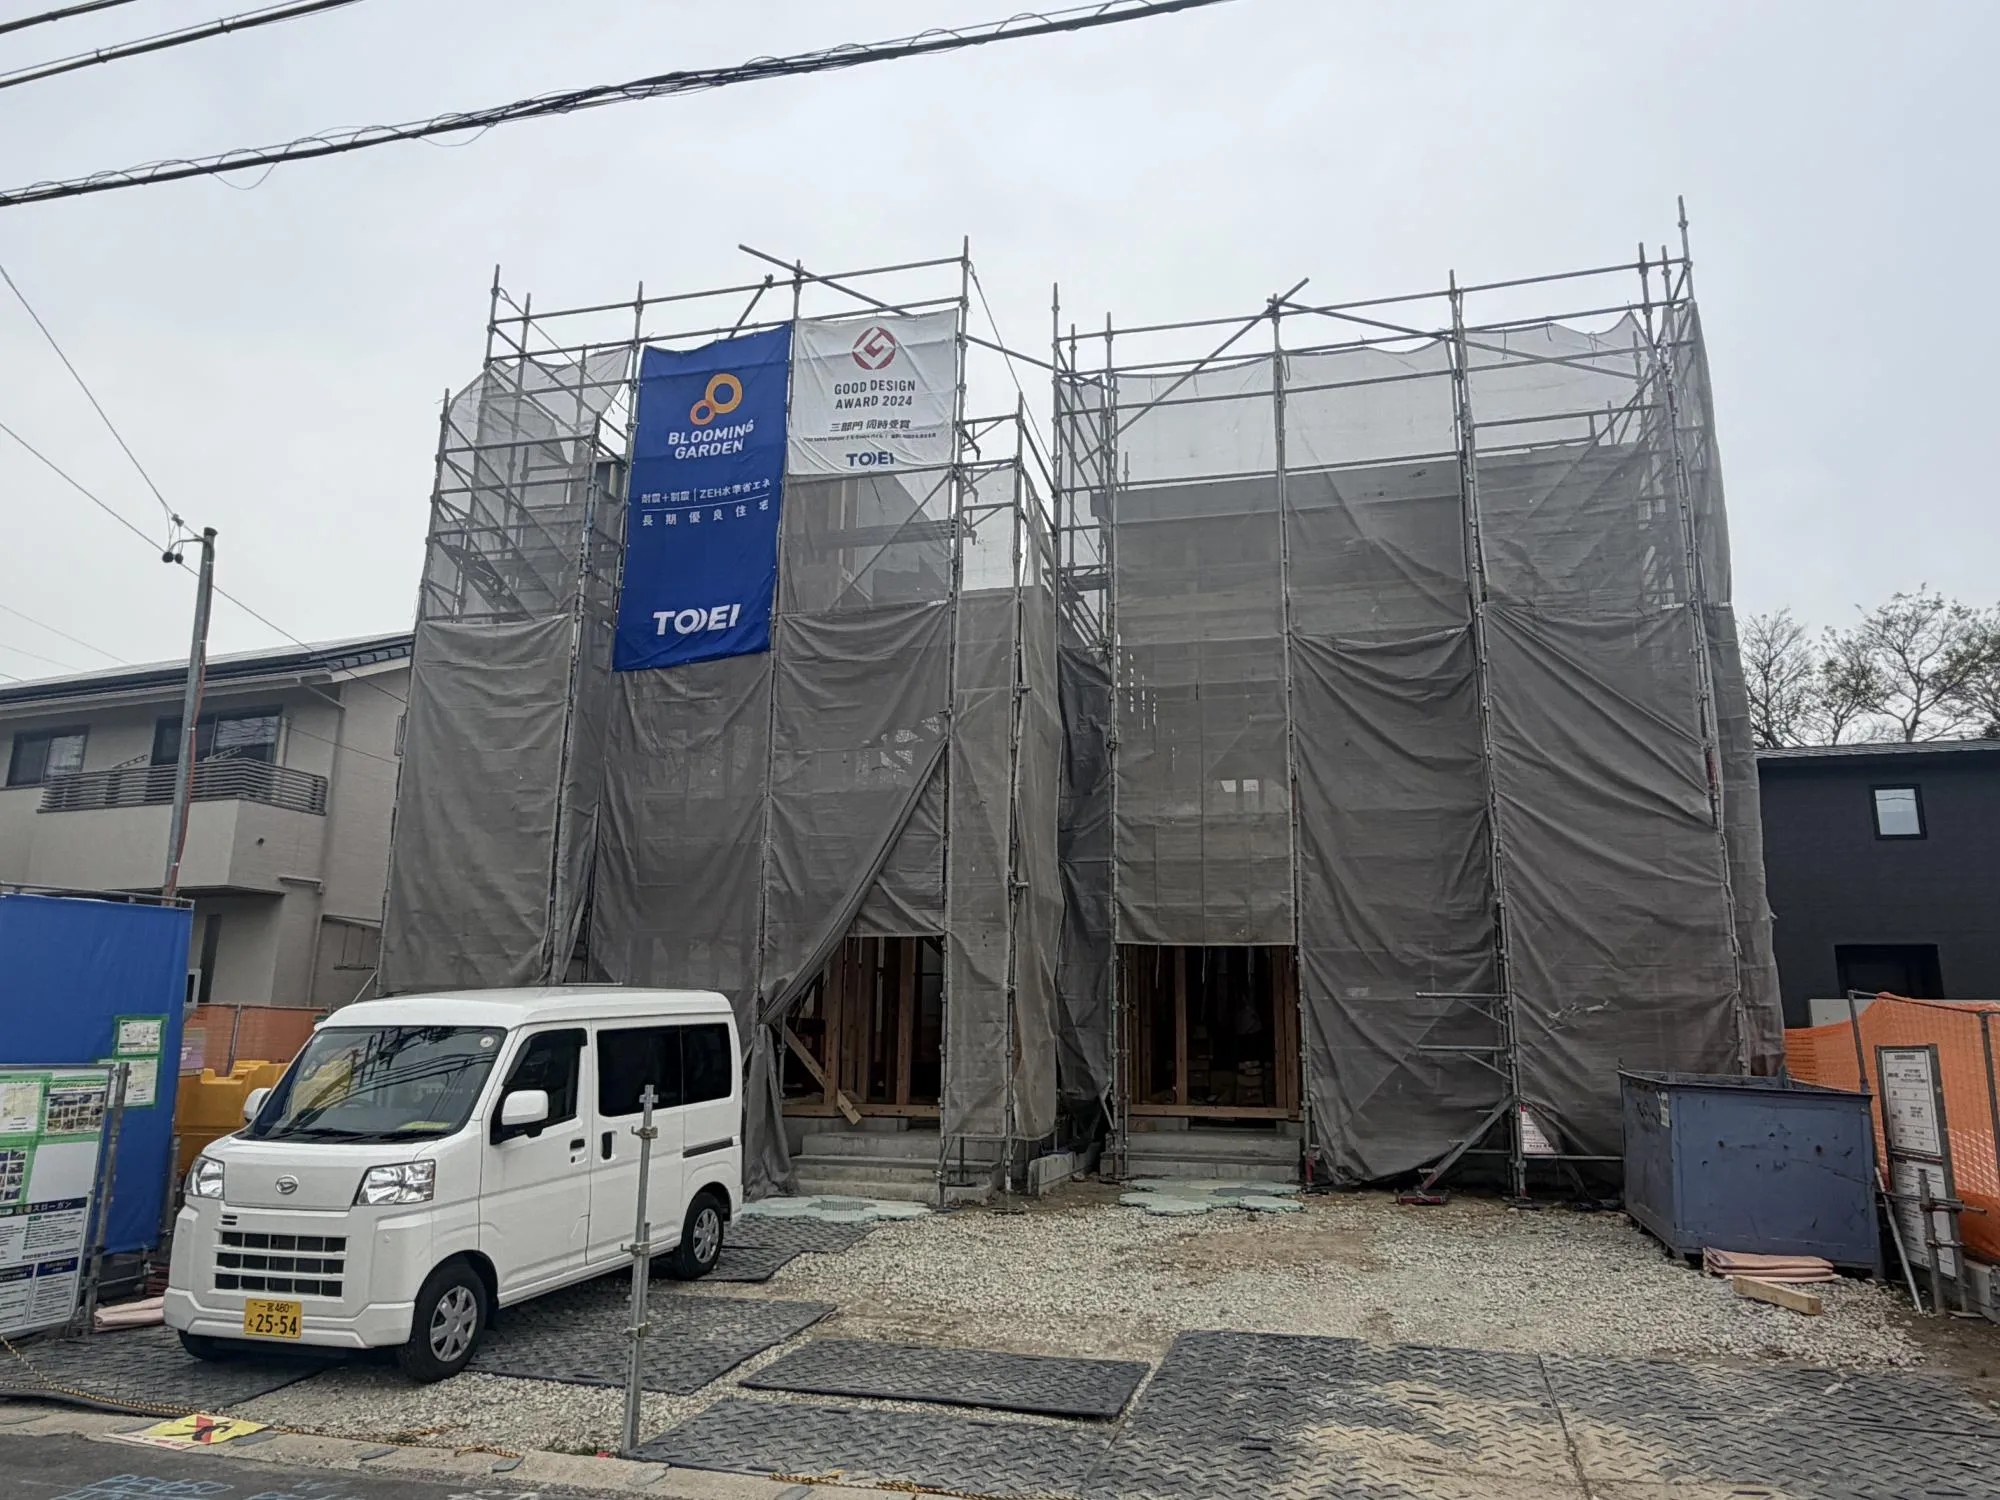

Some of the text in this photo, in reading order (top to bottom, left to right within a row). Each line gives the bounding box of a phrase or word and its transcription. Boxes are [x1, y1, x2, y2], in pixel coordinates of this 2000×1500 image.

[834, 380, 915, 395] GOOD DESIGN
[835, 395, 912, 410] AWARD 2024
[668, 419, 754, 445] BLOOMING
[830, 419, 911, 432] 三部門 同時受賞
[674, 438, 744, 459] GARDEN
[642, 499, 769, 526] 長期優良住宅
[255, 1313, 297, 1335] 25-54
